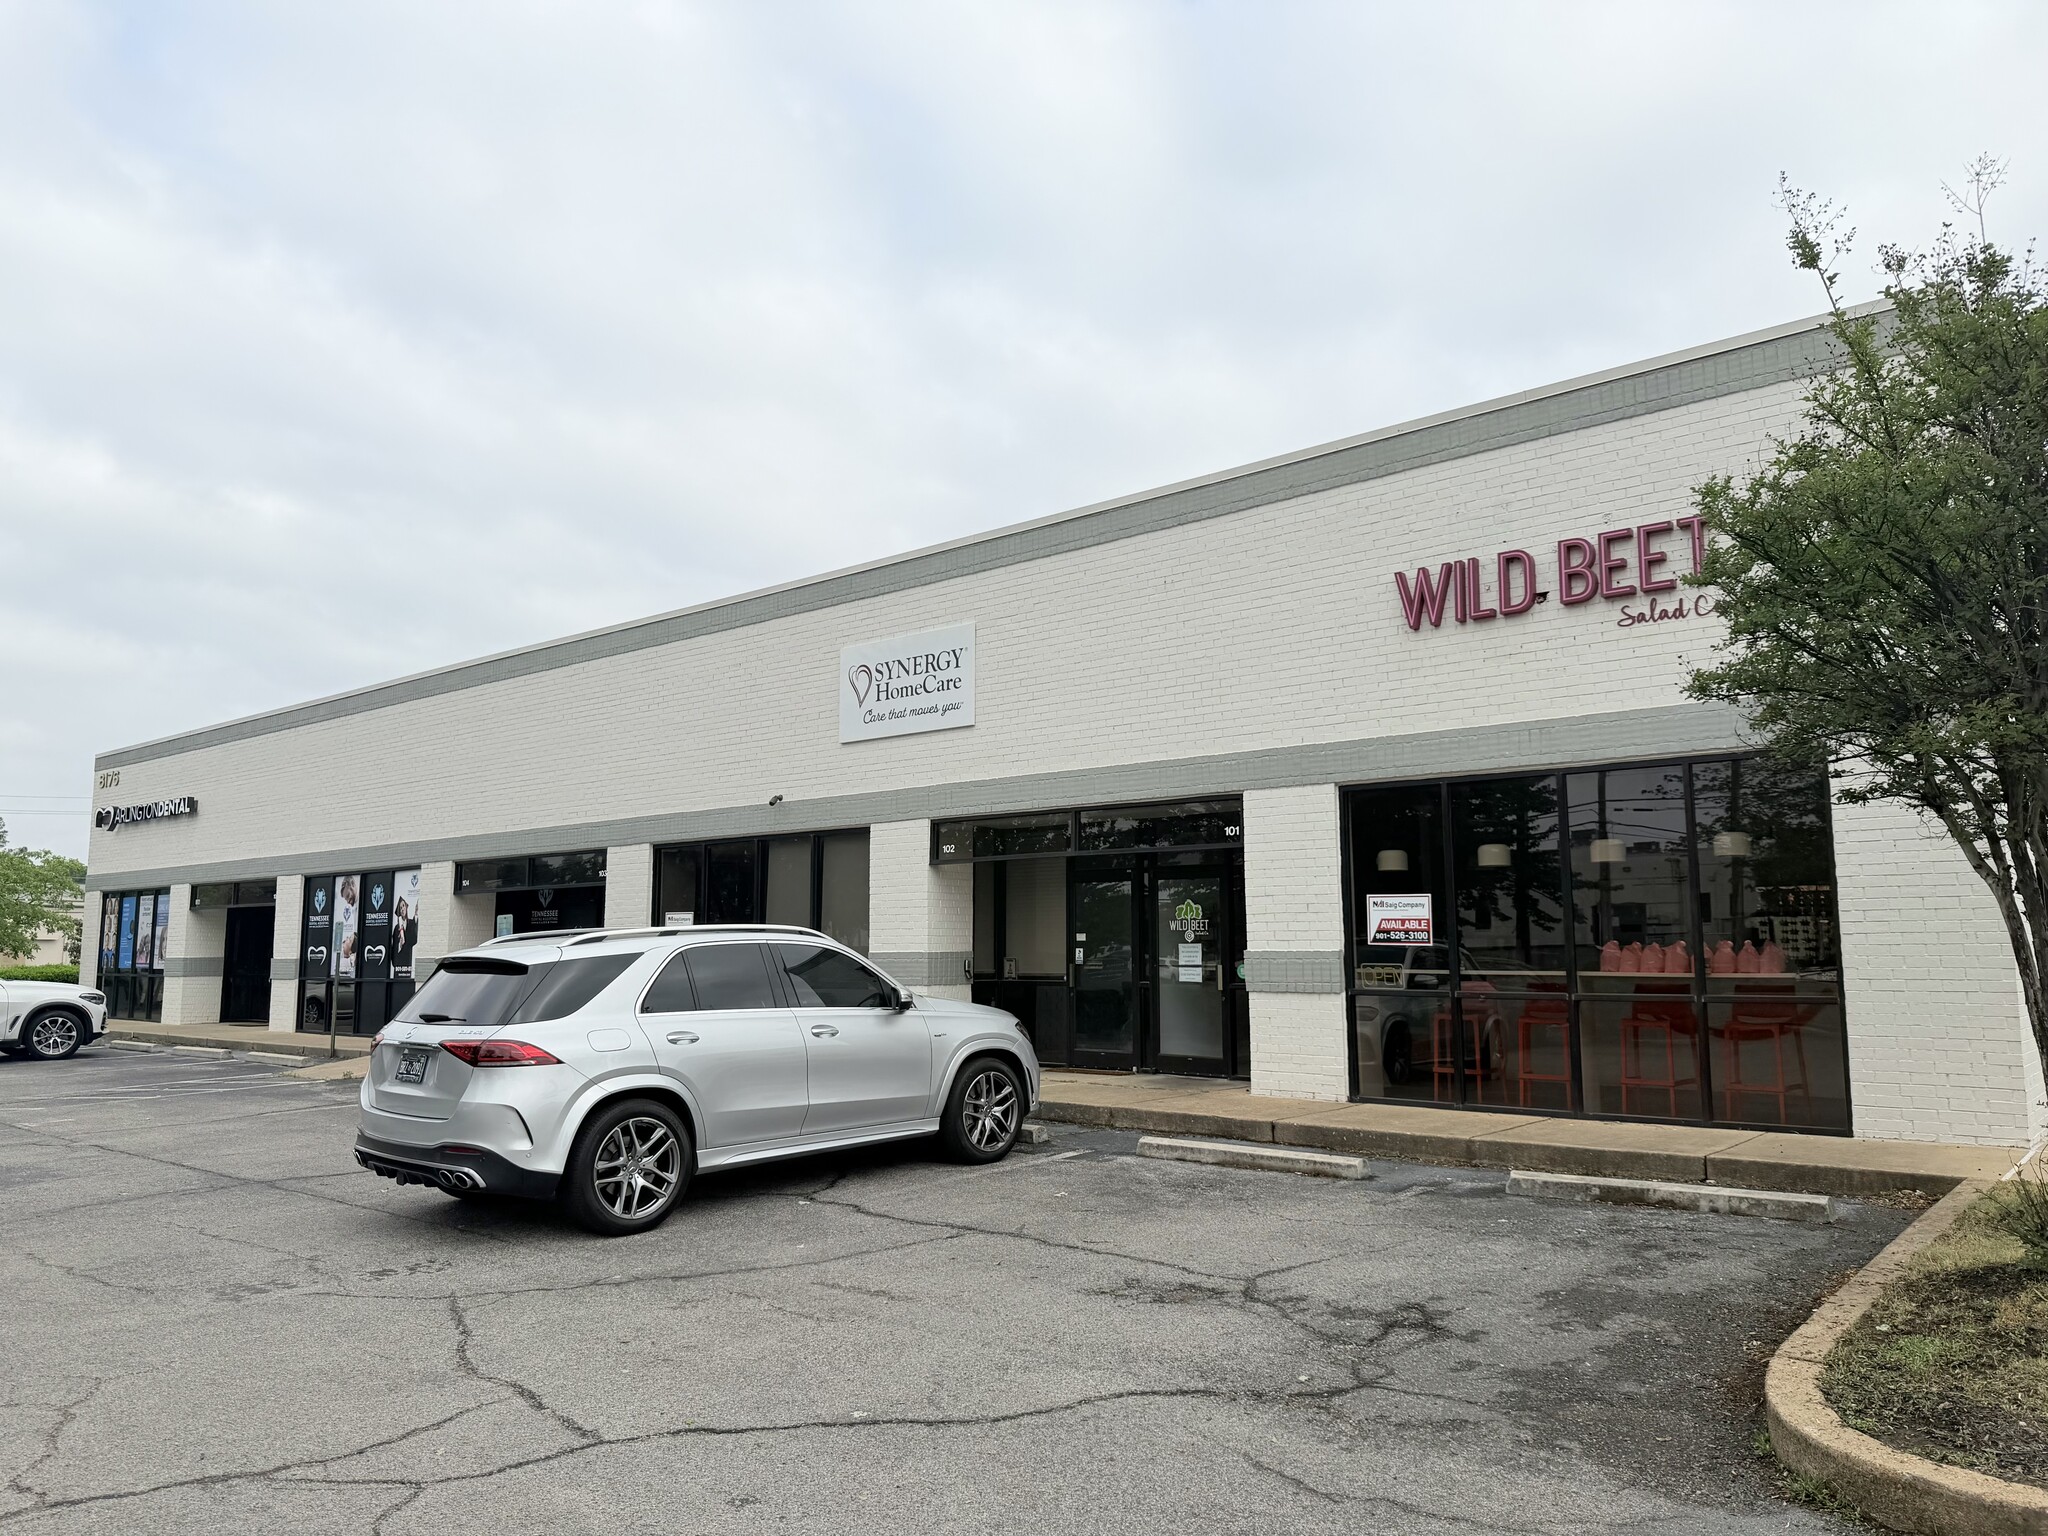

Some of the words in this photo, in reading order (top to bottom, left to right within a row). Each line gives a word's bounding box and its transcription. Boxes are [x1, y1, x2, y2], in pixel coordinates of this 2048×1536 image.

[1394, 549, 1537, 631] WILD
[1557, 514, 1707, 606] BEET
[1617, 597, 1690, 627] Salad
[874, 647, 964, 682] SYNERGY
[875, 674, 962, 702] HomeCare
[863, 708, 886, 724] Care
[888, 708, 907, 720] that
[909, 706, 940, 717] moves
[941, 702, 962, 716] you
[99, 771, 120, 789] 8176
[114, 796, 192, 823] ARLINGTONDENTAL
[1224, 826, 1240, 836] 101
[942, 844, 955, 853] 102
[1385, 901, 1397, 909] Saig
[1398, 901, 1425, 909] Company
[1169, 920, 1188, 931] WILD
[1191, 919, 1209, 931] BEET
[1380, 920, 1428, 929] AVAILABLE
[1375, 931, 1429, 940] 901-526-3100
[1363, 966, 1403, 985] OPEN
